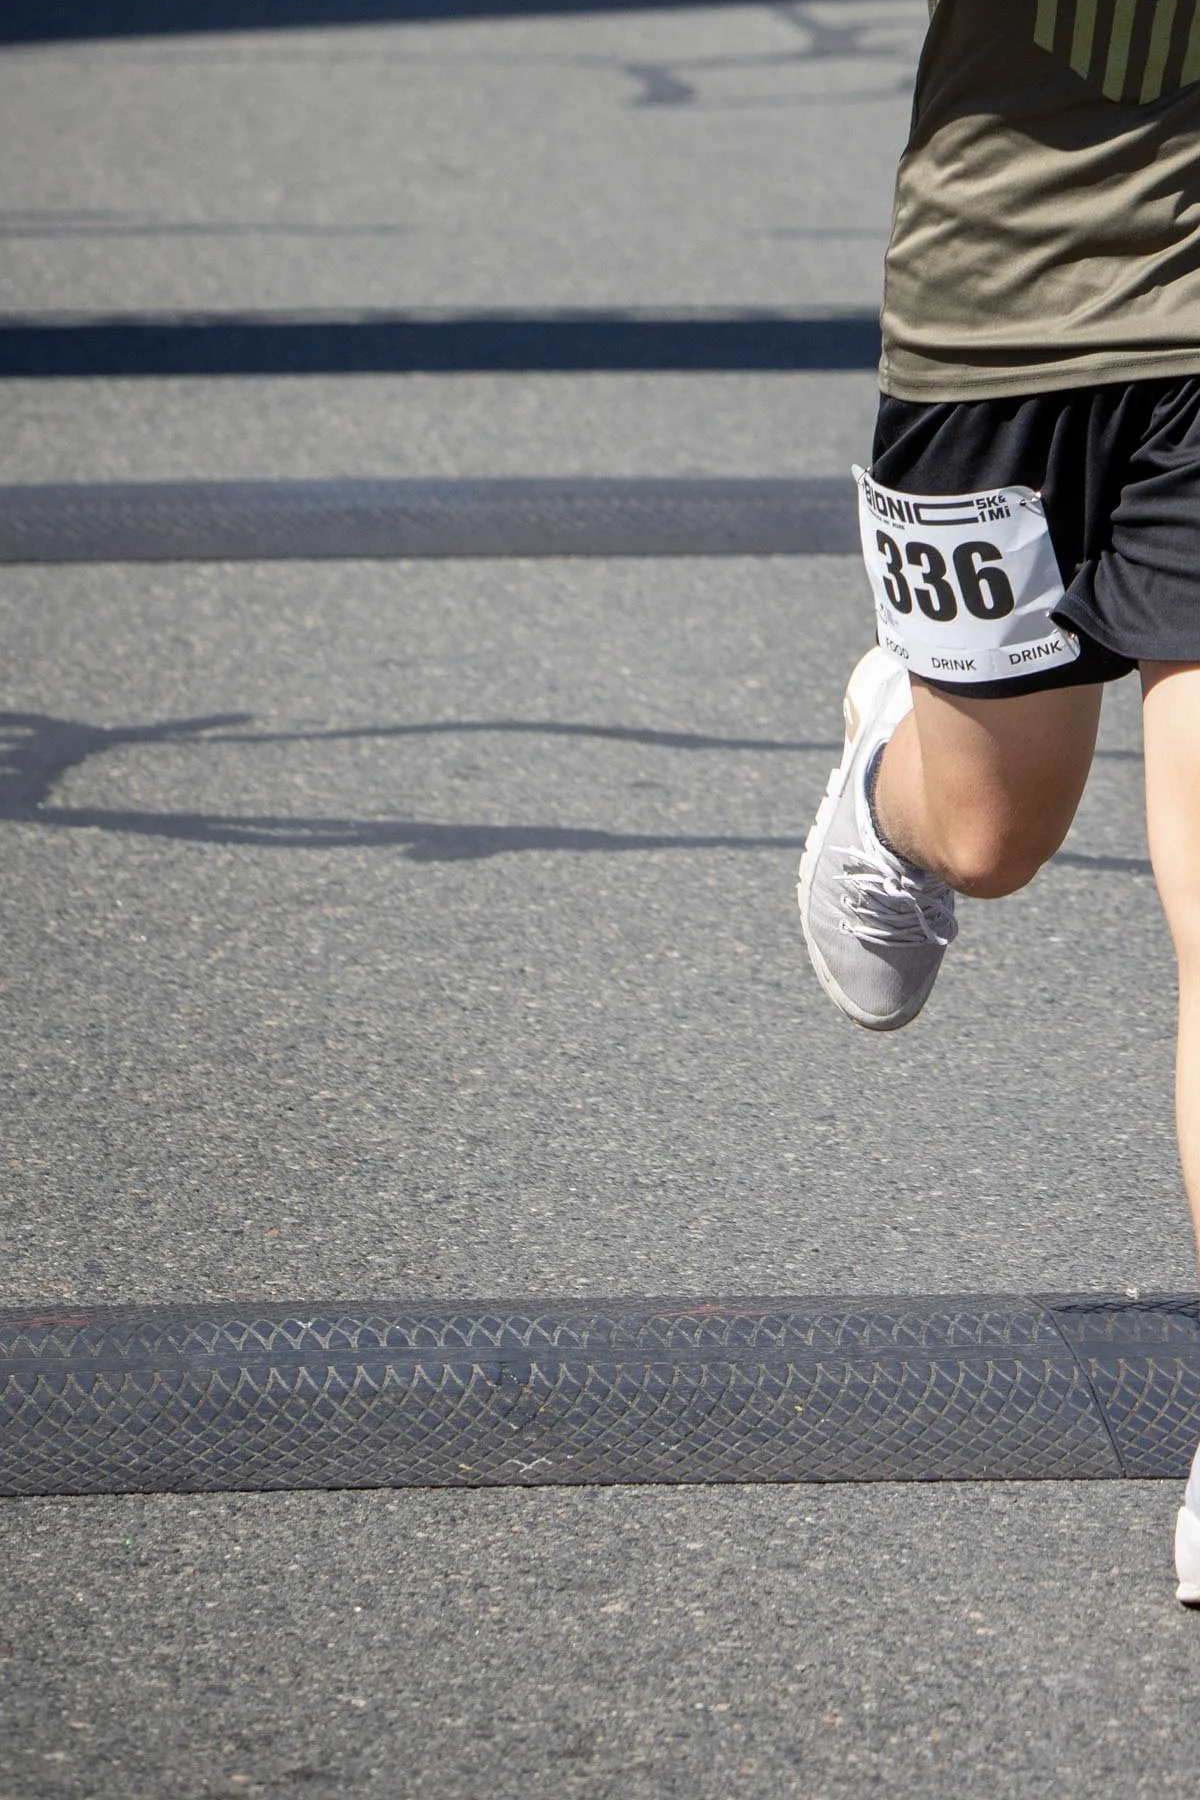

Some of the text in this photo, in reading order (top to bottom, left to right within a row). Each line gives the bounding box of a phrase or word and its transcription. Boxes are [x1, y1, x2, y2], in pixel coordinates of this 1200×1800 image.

[864, 478, 979, 527] BIONIC
[976, 495, 1007, 510] 5K&
[875, 529, 1015, 622] 336
[886, 637, 910, 661] FOOD
[1009, 640, 1063, 666] DRINK
[931, 657, 977, 672] DRINK
